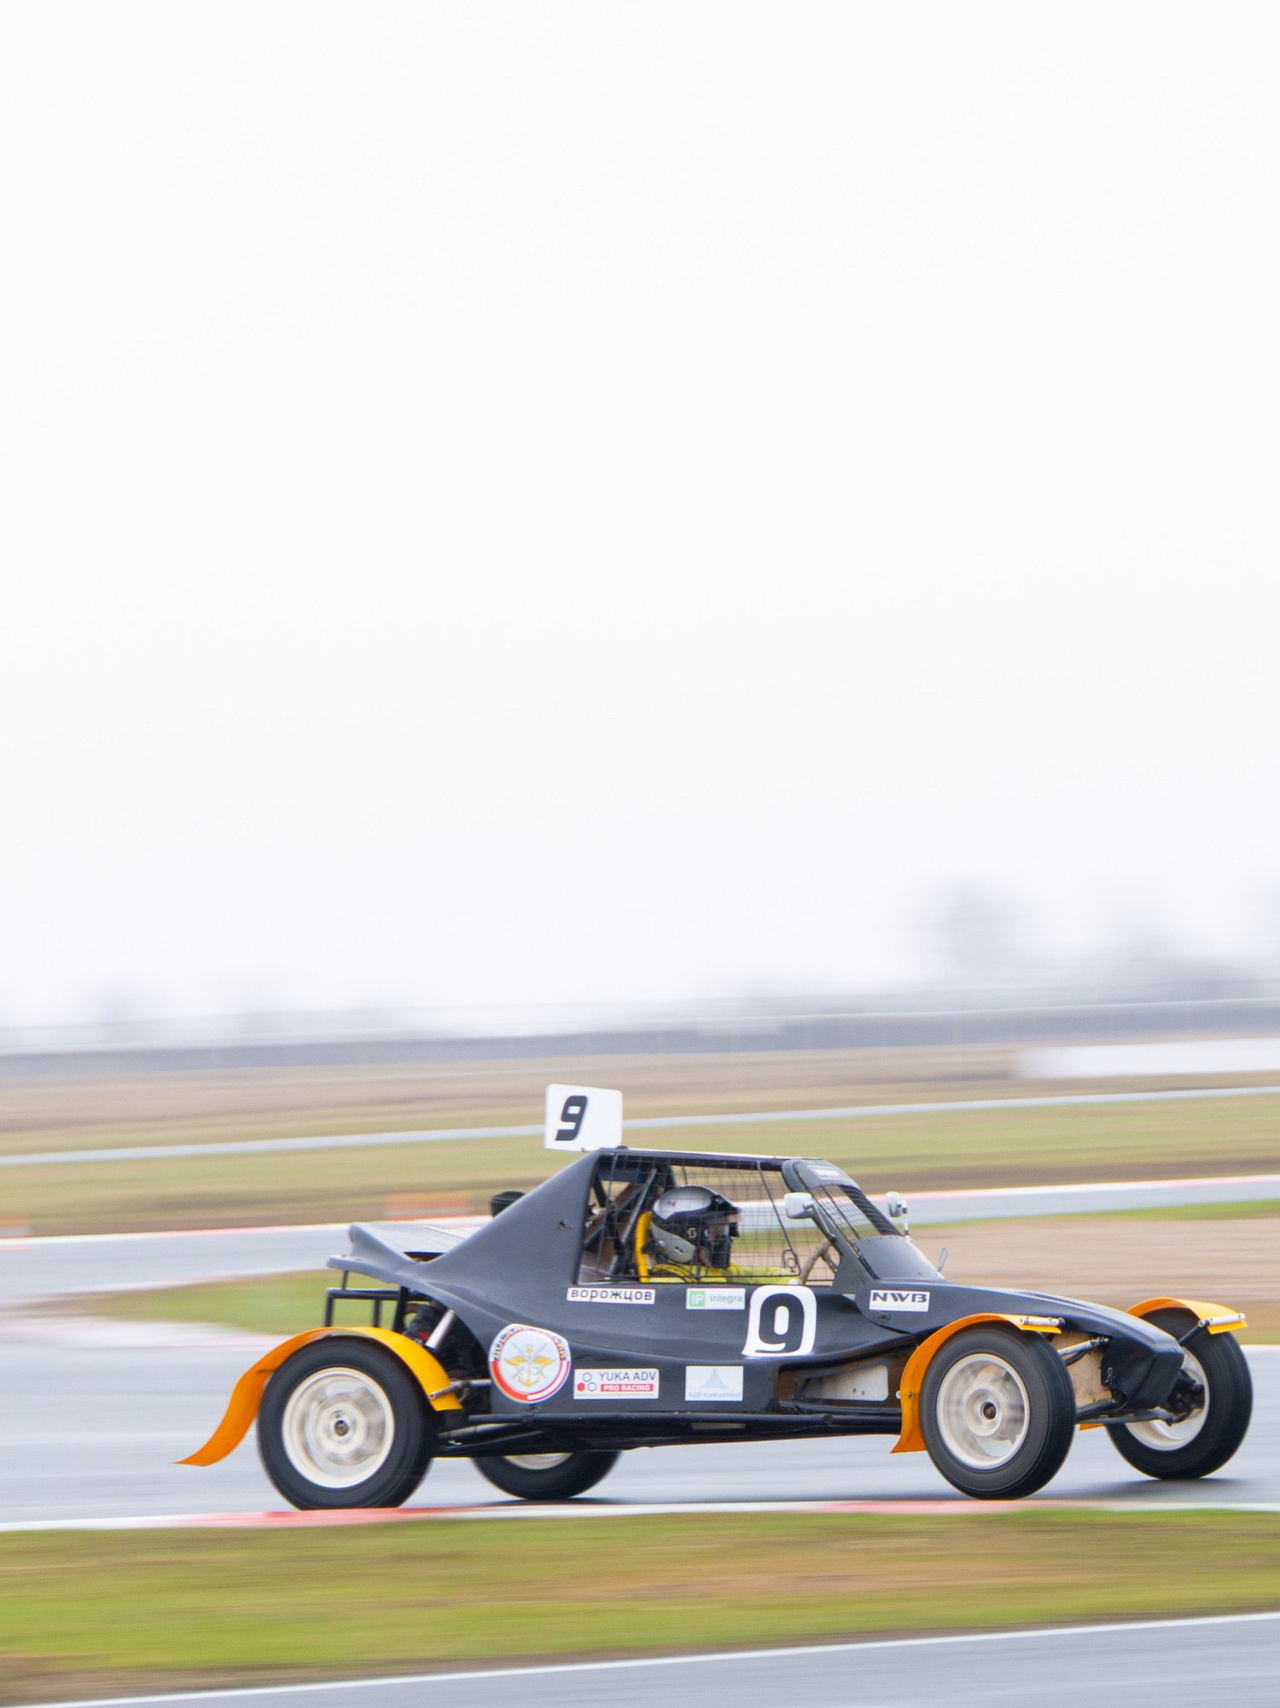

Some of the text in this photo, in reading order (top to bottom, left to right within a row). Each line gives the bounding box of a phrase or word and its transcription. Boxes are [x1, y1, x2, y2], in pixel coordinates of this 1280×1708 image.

[555, 1095, 588, 1141] 9
[872, 1292, 927, 1302] NWB
[754, 1293, 804, 1353] 9
[599, 1371, 656, 1381] YUKA ADV
